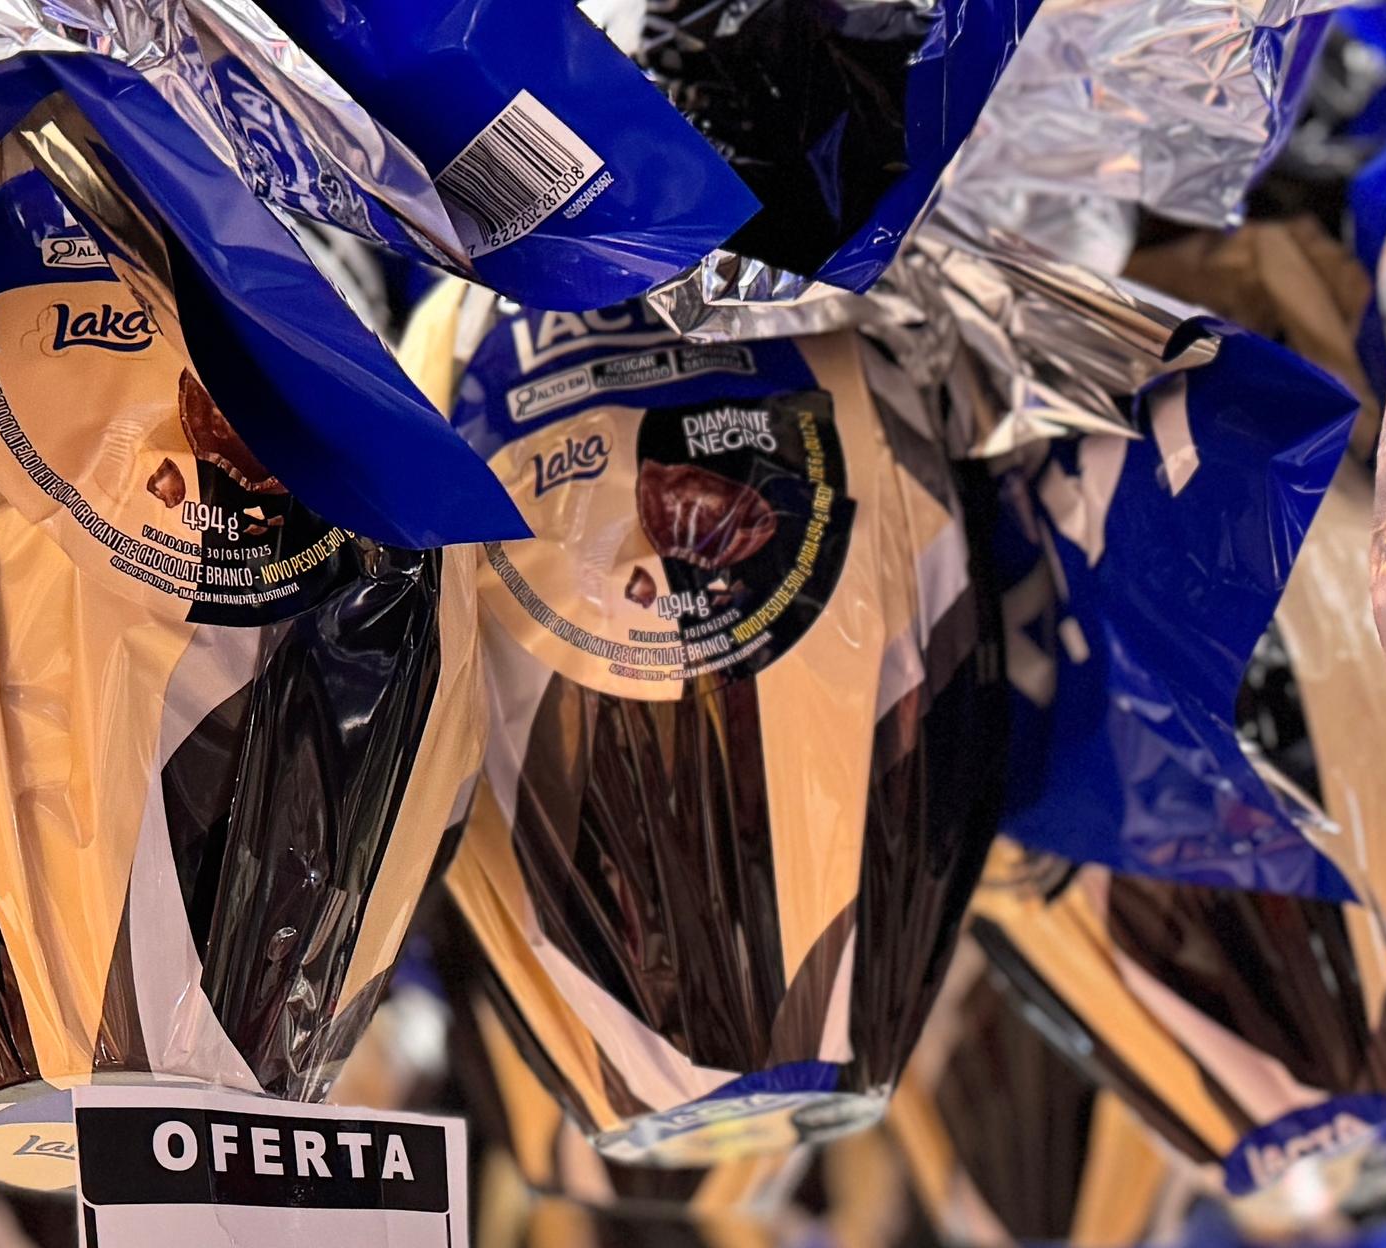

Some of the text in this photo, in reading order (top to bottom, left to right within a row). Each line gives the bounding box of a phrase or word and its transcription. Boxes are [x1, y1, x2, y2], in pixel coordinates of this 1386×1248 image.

[469, 166, 585, 256] 7 622202 287008
[52, 303, 157, 352] Laka
[537, 375, 585, 402] ALTO EM
[682, 408, 771, 435] DIAMANTE
[687, 427, 777, 458] NEGRO
[16, 449, 42, 470] AO
[534, 435, 611, 498] Laka
[28, 463, 63, 496] LEITE
[53, 482, 81, 508] COM
[71, 500, 132, 557] CROCANTE
[182, 501, 239, 541] 494 g
[807, 519, 824, 541] 494
[312, 539, 331, 561] DE
[324, 526, 345, 552] 500
[136, 545, 204, 584] CHOCOLATE
[290, 548, 318, 575] PESO
[797, 539, 820, 567] PARA
[206, 564, 253, 587] BRANCO
[260, 559, 293, 585] NOVO
[490, 549, 530, 600] HOCOLATE
[784, 569, 805, 599] 500
[179, 586, 212, 602] IMAGEM
[213, 591, 257, 606] MERAMENTE
[257, 583, 300, 602] ILUSTRATIVA
[657, 591, 710, 620] 494 g
[775, 586, 793, 605] DE
[756, 598, 783, 625] PESO
[550, 616, 575, 642] COM
[732, 616, 762, 643] NOVO
[570, 625, 622, 661] CROCANTE
[629, 645, 687, 665] CHOCOLATE
[686, 634, 730, 662] BRANCO
[13, 1134, 76, 1161] La
[152, 1120, 416, 1182] OFERTA
